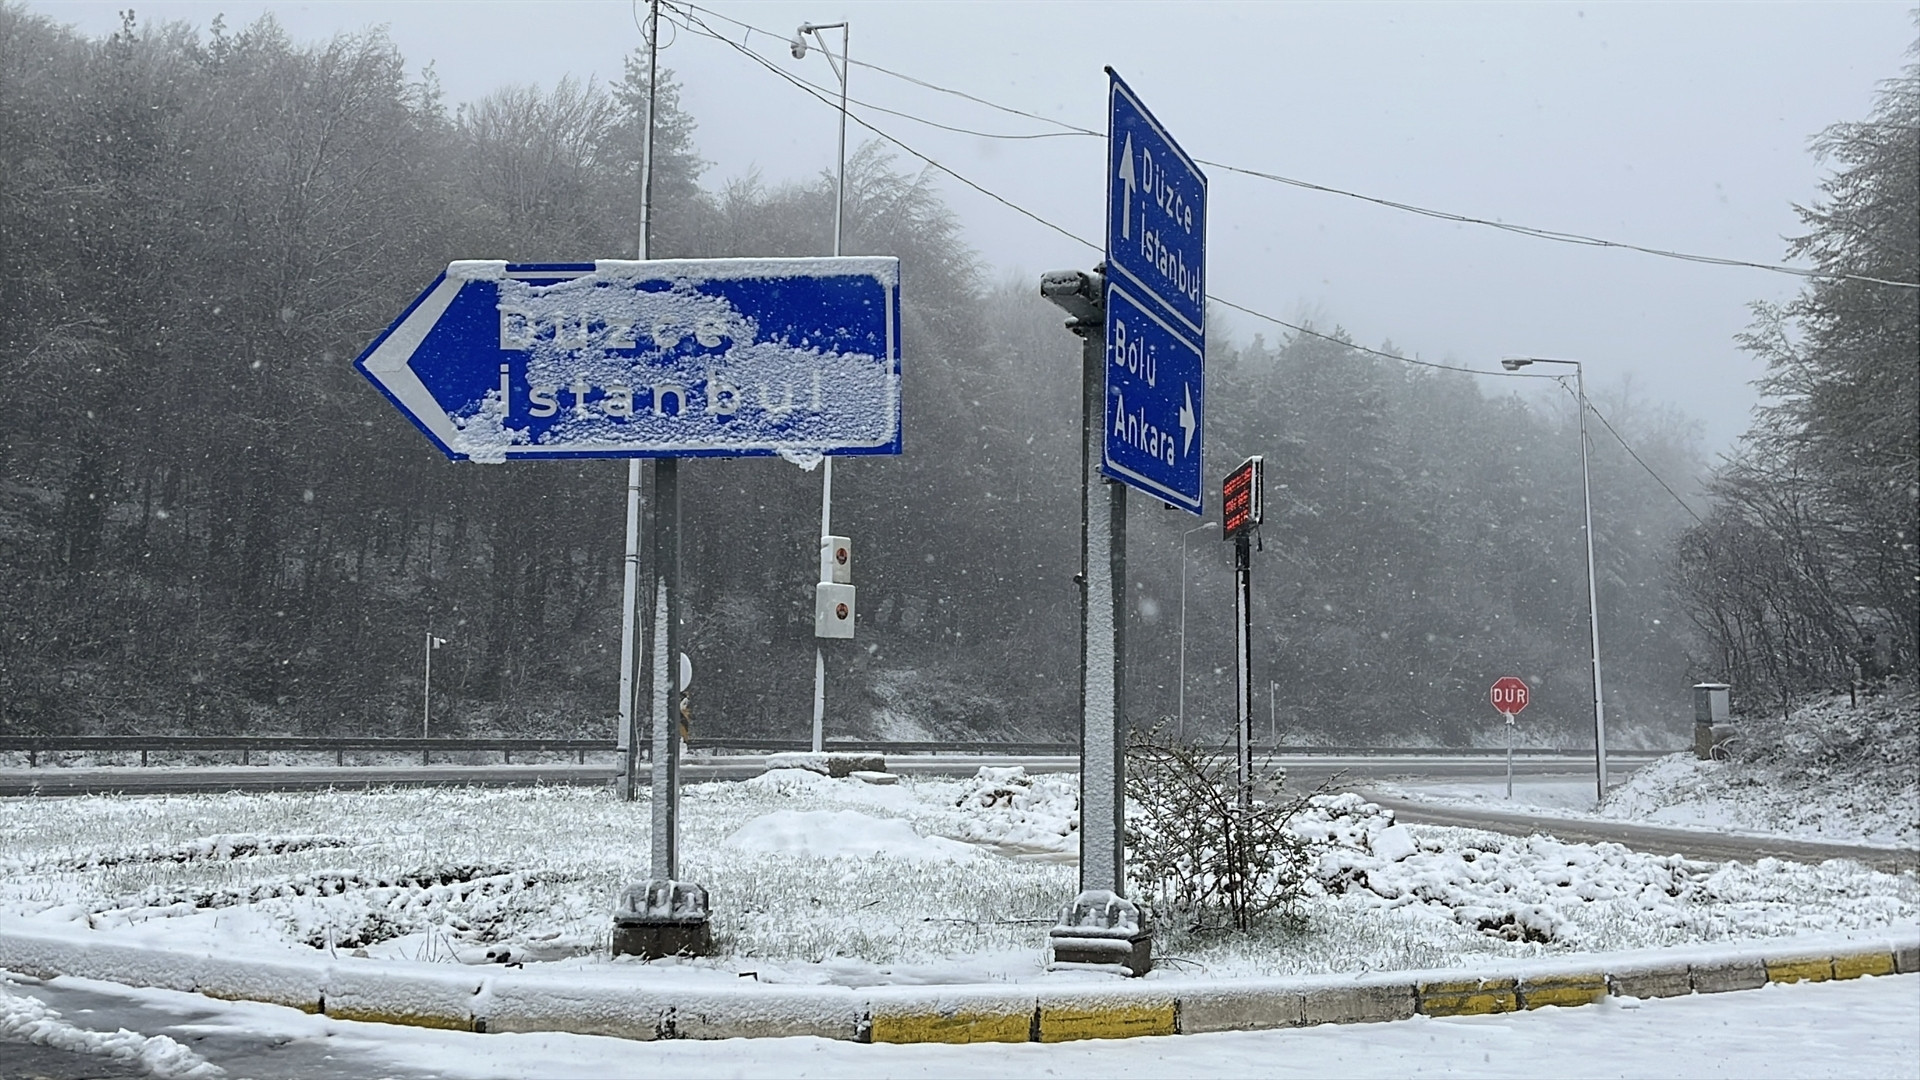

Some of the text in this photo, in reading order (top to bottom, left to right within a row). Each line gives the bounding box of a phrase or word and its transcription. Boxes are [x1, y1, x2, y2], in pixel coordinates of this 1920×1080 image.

[1143, 147, 1193, 235] Düzce
[1141, 200, 1200, 306] İstanbul
[1115, 318, 1156, 388] Bolu
[500, 363, 821, 417] İstanbul
[1114, 394, 1175, 467] Ankara
[1493, 688, 1526, 703] DUR
